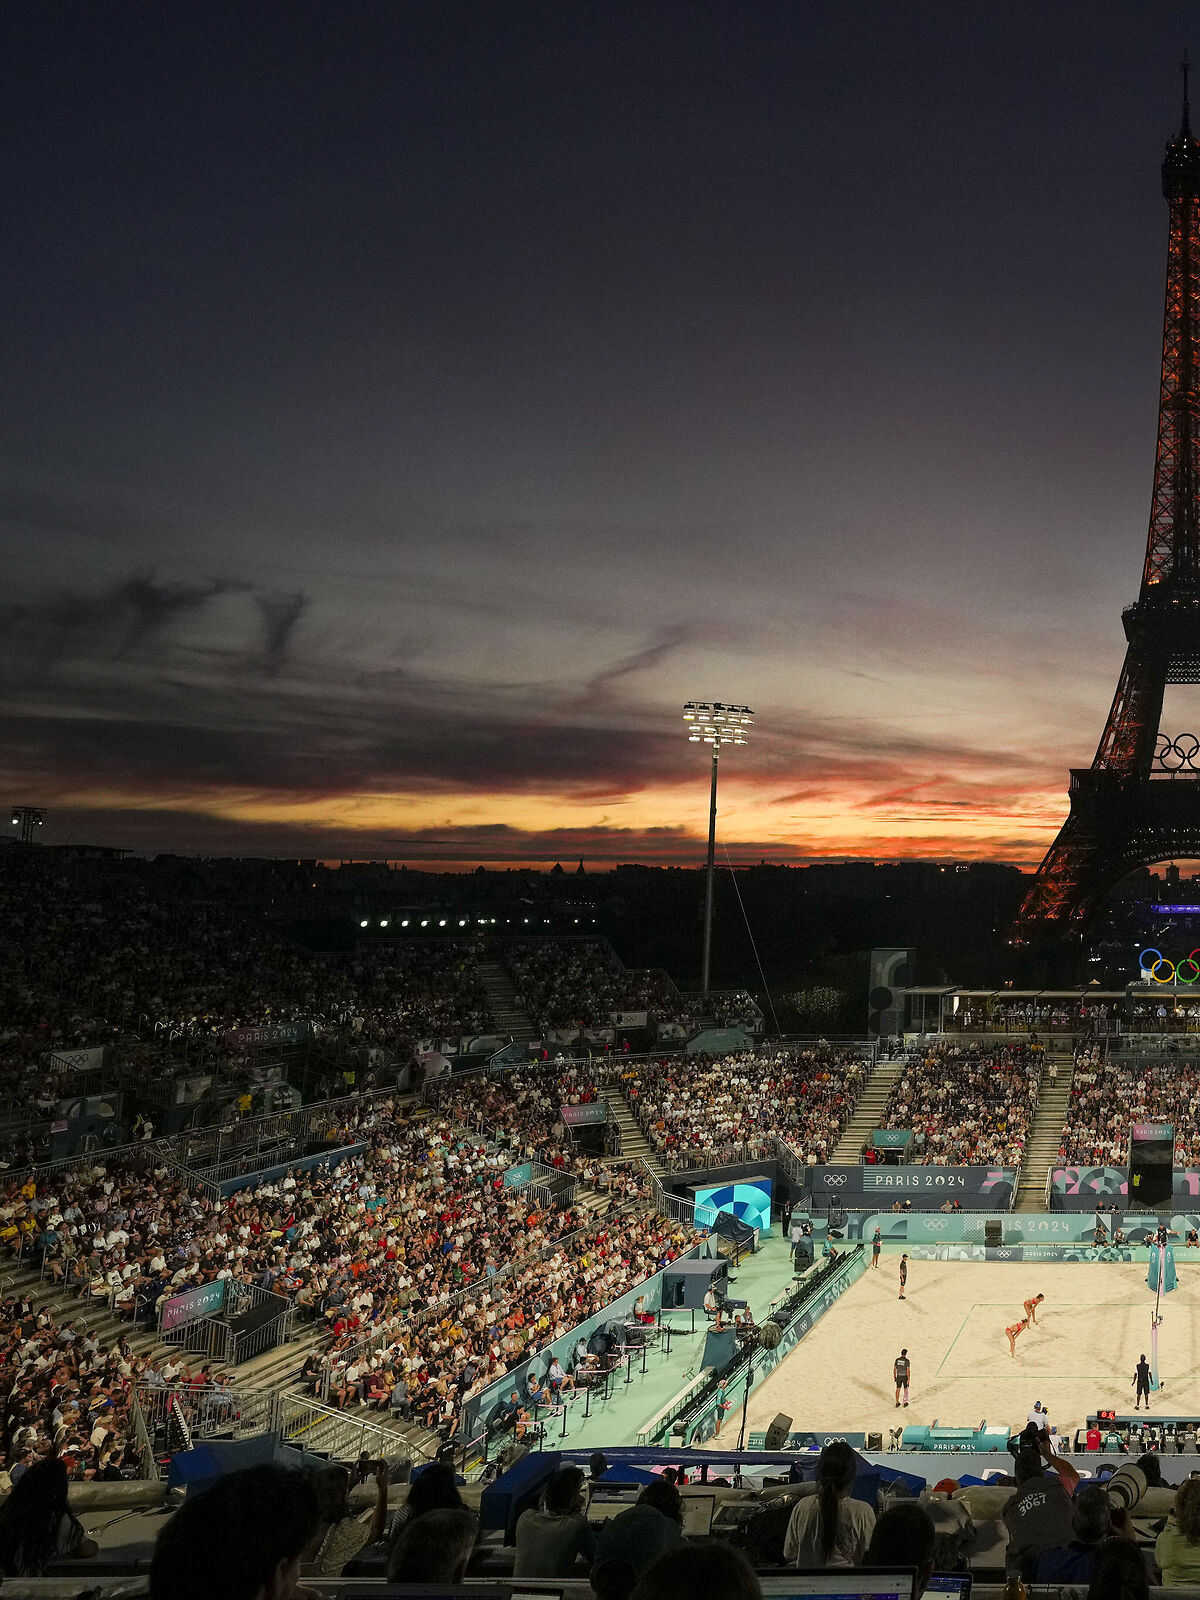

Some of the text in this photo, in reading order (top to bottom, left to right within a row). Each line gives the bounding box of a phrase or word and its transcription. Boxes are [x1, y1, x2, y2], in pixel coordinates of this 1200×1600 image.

[875, 1175, 965, 1186] PARIS 2024
[976, 1221, 1069, 1232] PIS 2024
[167, 1292, 220, 1317] PARIS 2024
[1020, 1494, 1046, 1517] 3067
